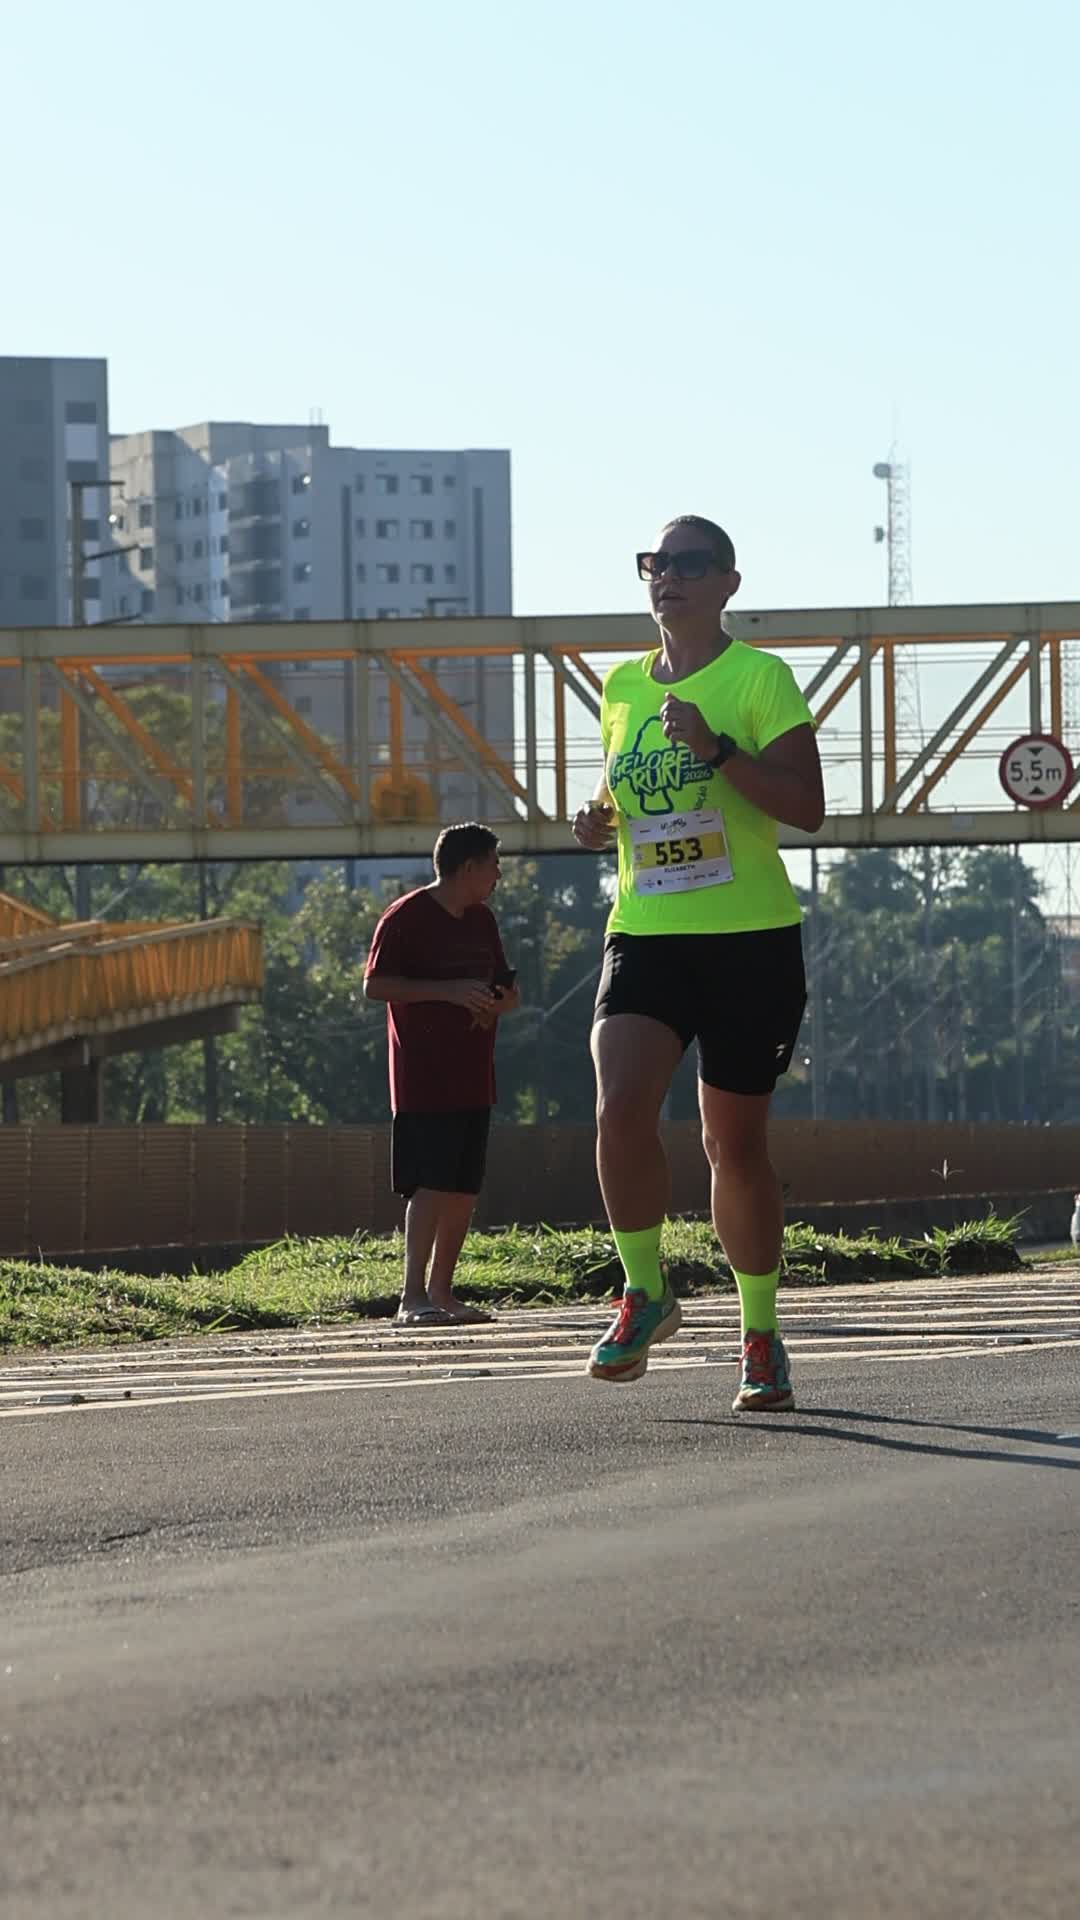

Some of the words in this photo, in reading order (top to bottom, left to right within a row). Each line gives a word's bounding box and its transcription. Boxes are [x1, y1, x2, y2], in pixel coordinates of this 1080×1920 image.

[632, 767, 681, 793] RUN
[683, 769, 711, 780] 2026
[655, 837, 703, 865] 553
